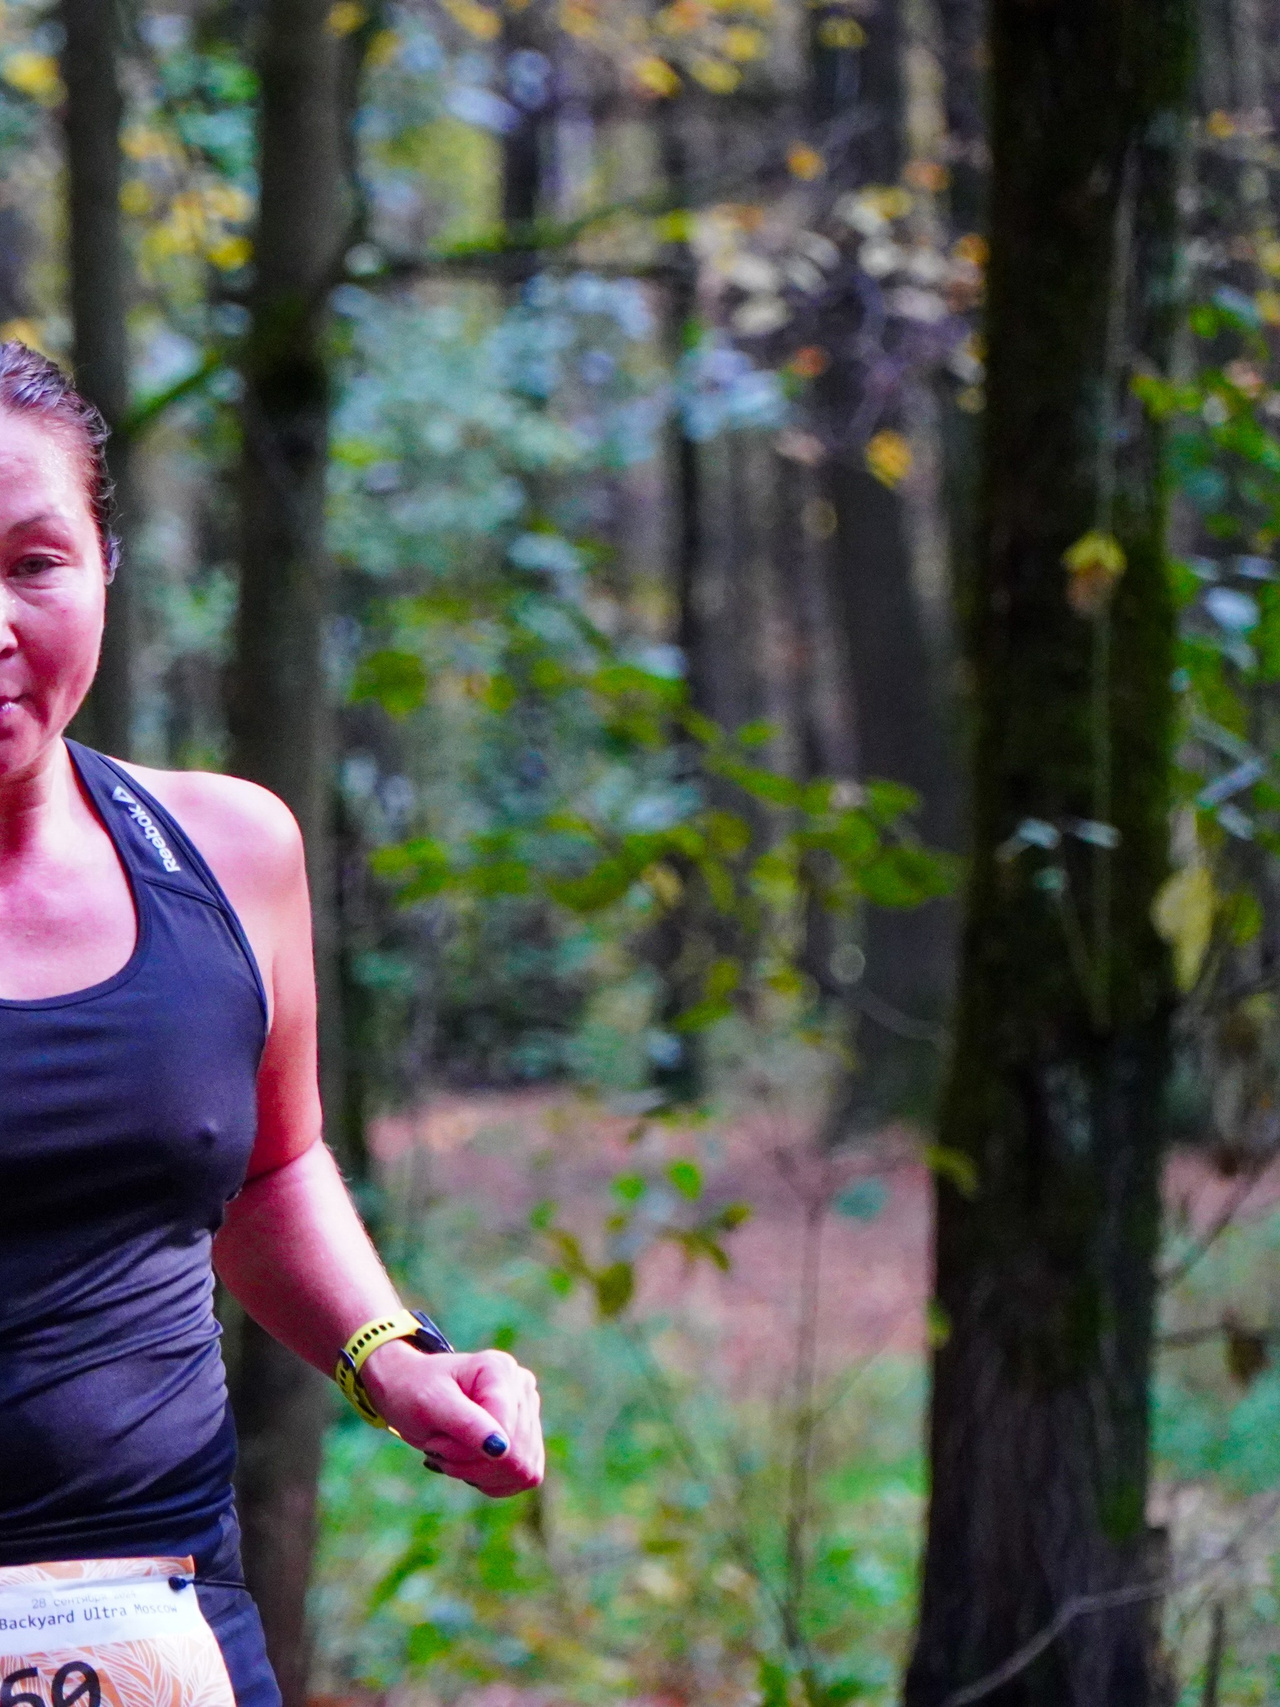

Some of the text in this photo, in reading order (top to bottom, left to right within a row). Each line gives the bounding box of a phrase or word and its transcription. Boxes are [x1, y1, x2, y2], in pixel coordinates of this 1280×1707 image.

[128, 804, 181, 872] Reebok
[31, 1597, 47, 1609] 28
[84, 1607, 127, 1621] Ultra
[133, 1603, 178, 1615] Moscow
